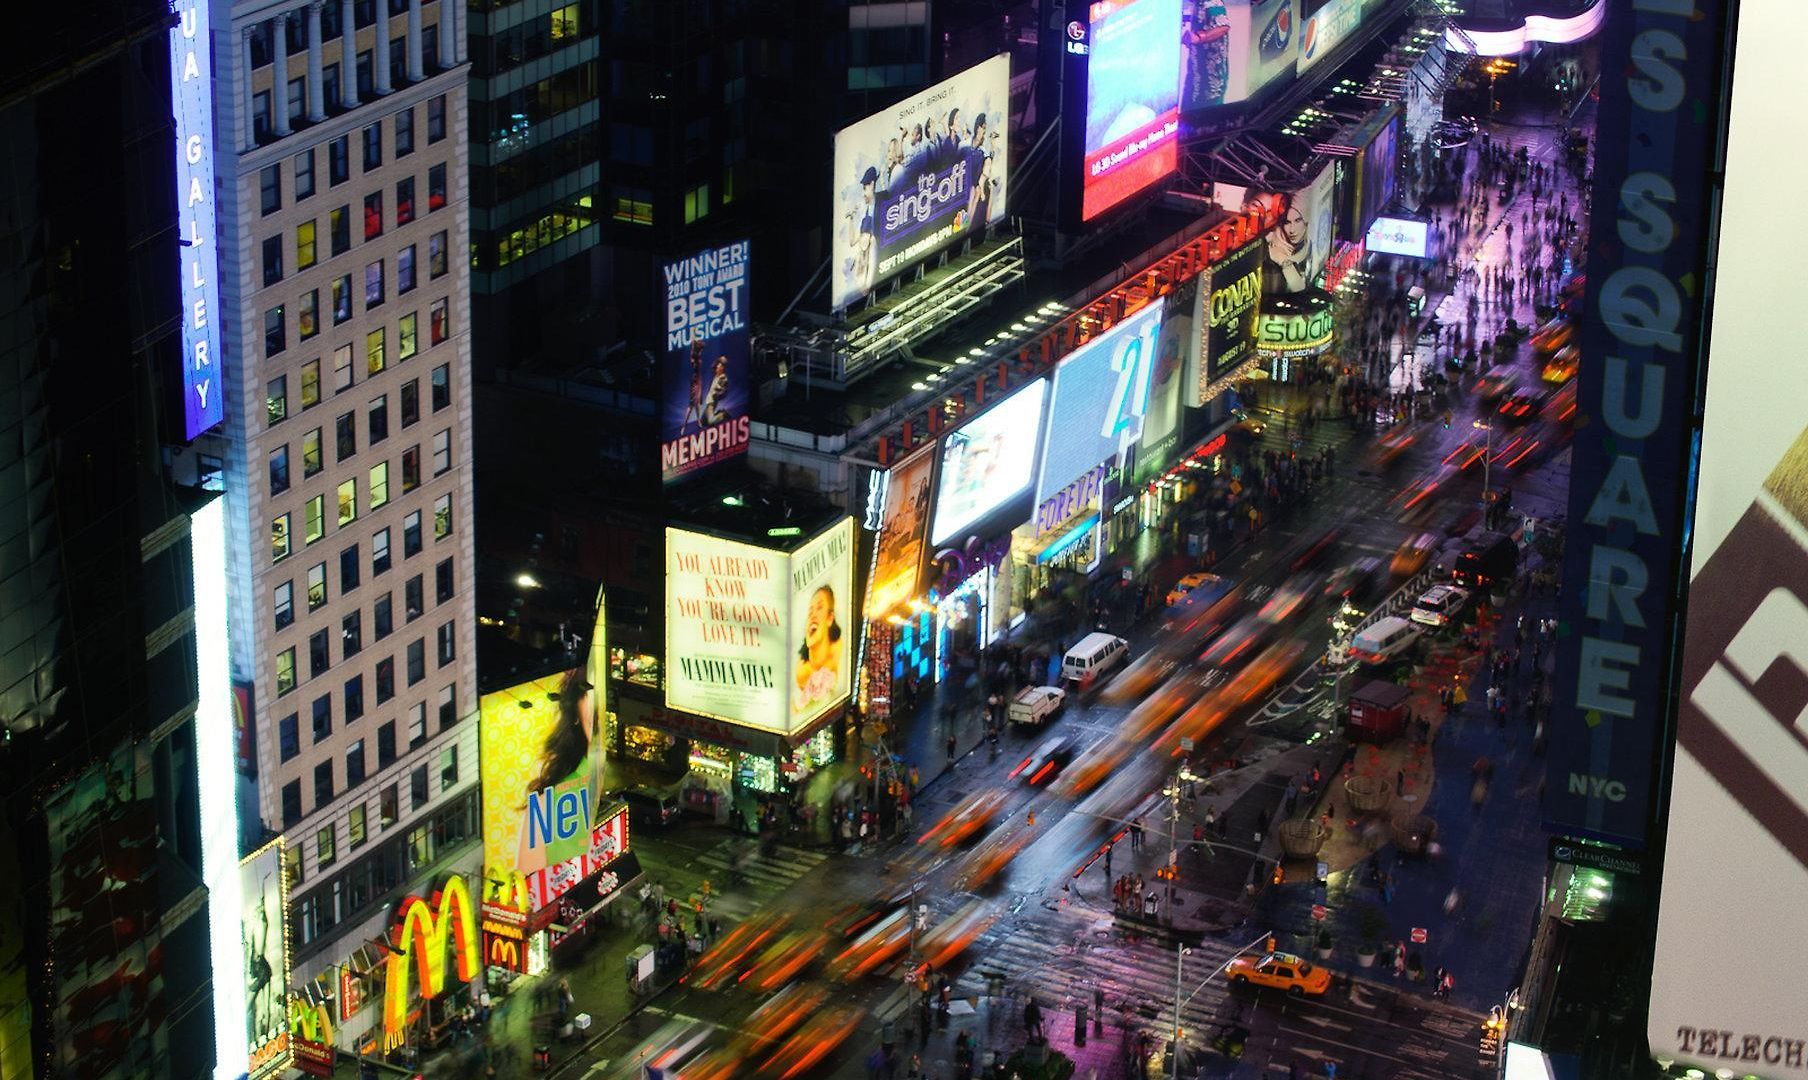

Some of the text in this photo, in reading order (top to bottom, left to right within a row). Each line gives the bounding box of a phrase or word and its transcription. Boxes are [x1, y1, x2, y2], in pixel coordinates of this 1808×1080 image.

[885, 160, 966, 230] sing-off
[917, 173, 936, 191] the
[186, 135, 208, 409] GALLERY
[664, 241, 748, 284] WINNER!
[668, 280, 690, 299] 2010
[668, 278, 744, 332] BEST
[1209, 266, 1262, 328] CONAN
[668, 312, 744, 351] MUSICAL
[1101, 321, 1161, 441] 21
[662, 415, 749, 472] MEMPHIS
[1575, 171, 1683, 719] SQUARE
[677, 552, 769, 579] YOU ALREADY
[793, 530, 846, 590] MAMMA MIA!
[705, 577, 745, 599] KNOW
[678, 597, 779, 626] YOU'RE GONNA
[703, 623, 760, 647] LOVE IT!
[681, 657, 773, 688] MAMMA MIA!
[1568, 772, 1626, 802] NYC
